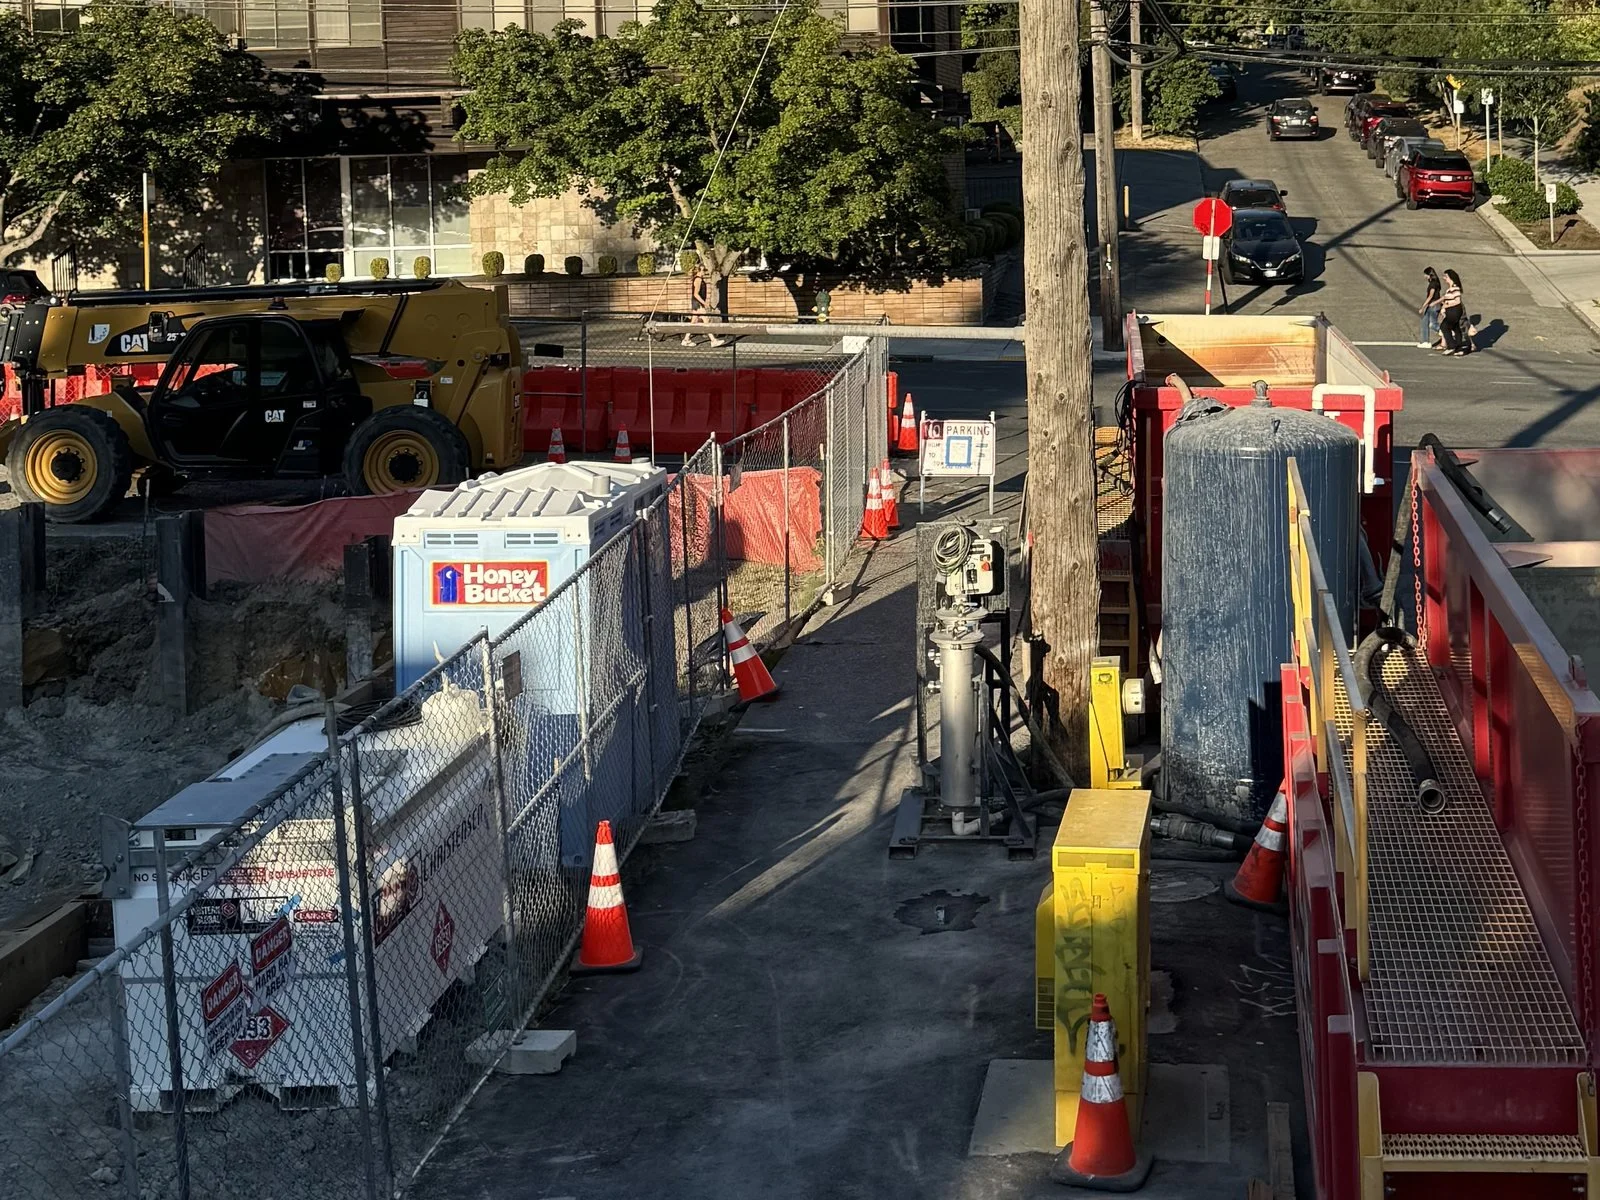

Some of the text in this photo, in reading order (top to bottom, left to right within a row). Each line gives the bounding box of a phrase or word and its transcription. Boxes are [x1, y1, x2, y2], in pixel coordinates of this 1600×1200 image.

[120, 333, 148, 353] CAT
[264, 409, 286, 423] CAT
[946, 425, 990, 436] PARKING
[463, 563, 539, 587] Honey
[464, 582, 546, 604] Bucket
[133, 873, 149, 882] NO
[254, 926, 289, 964] DANGER
[255, 965, 277, 992] HARD
[265, 976, 286, 998] AREA
[206, 970, 239, 1012] DANGER
[209, 1017, 243, 1058] KEEP OUT
